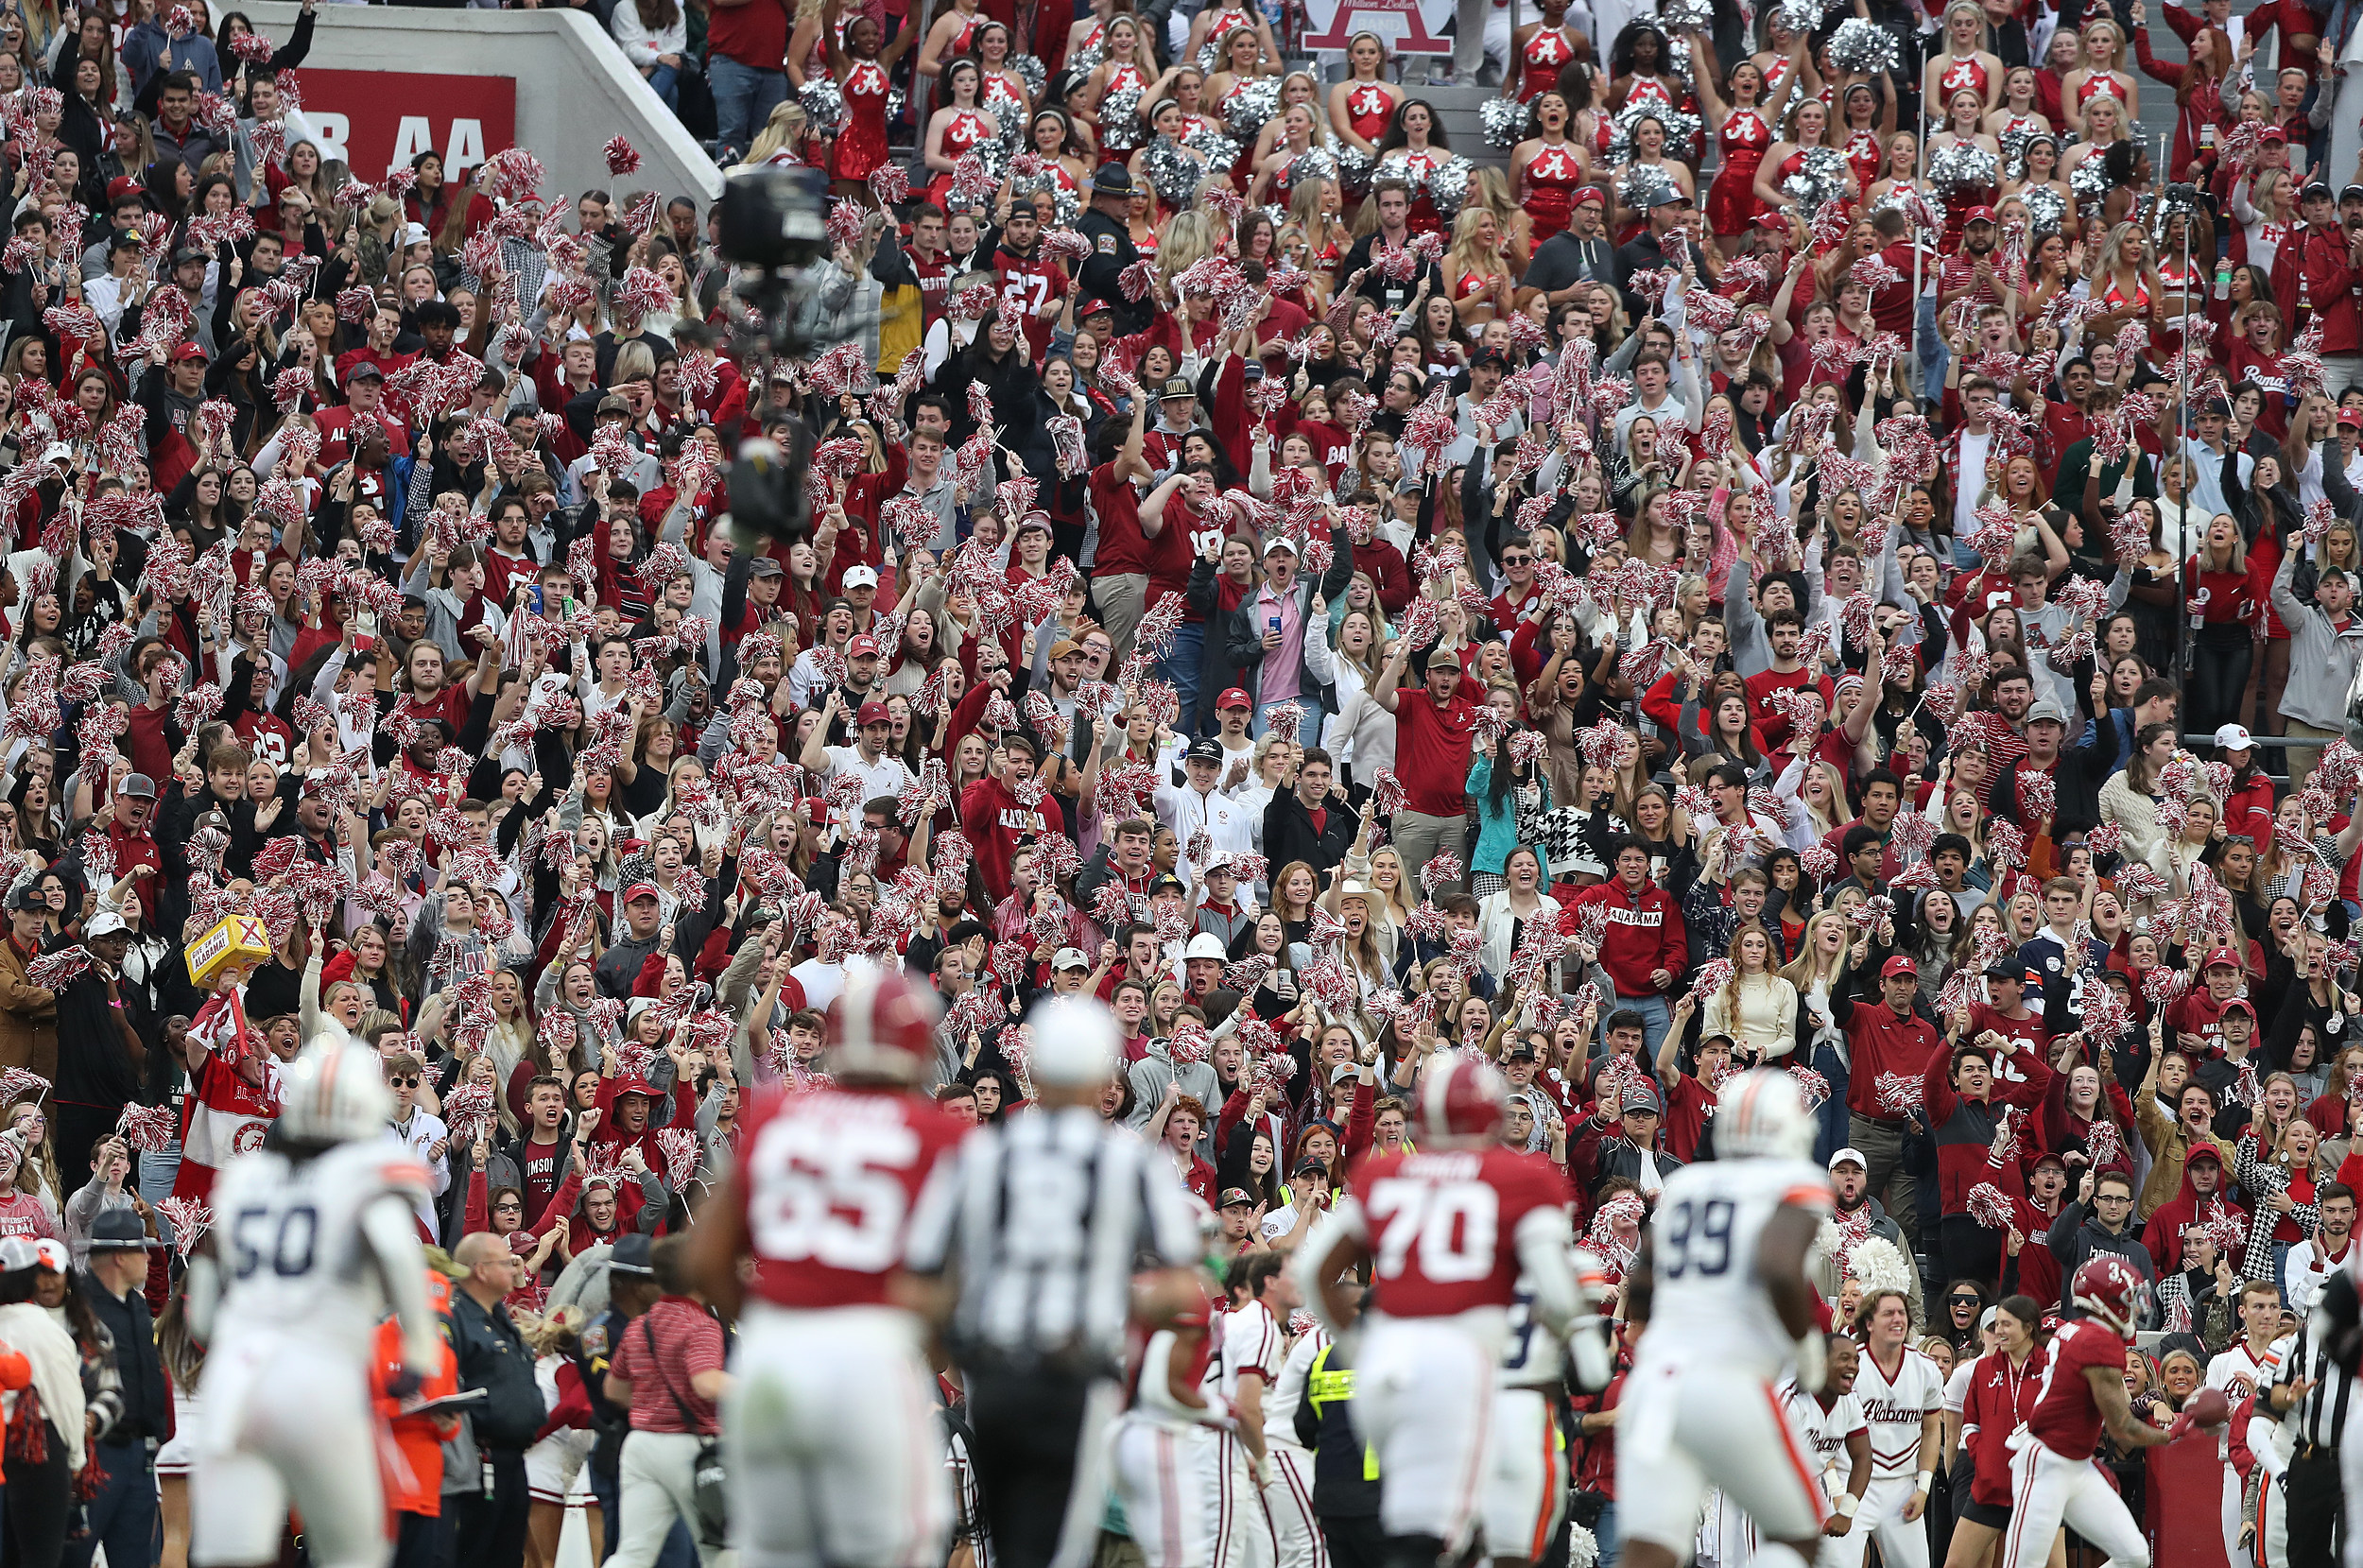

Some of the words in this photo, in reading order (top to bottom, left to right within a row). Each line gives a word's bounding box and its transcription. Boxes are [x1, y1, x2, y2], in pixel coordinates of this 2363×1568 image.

[1381, 0, 1417, 10] Dollar
[1355, 17, 1401, 32] BAND
[1527, 37, 1559, 65] A
[1943, 63, 1975, 88] A
[854, 68, 885, 95] A
[1353, 89, 1384, 115] A
[951, 116, 980, 143] A
[1726, 115, 1756, 142] A
[1840, 137, 1871, 160] A
[1532, 152, 1567, 181] A
[127, 177, 138, 187] A
[1974, 208, 1986, 216] A
[1005, 270, 1048, 316] 27
[1094, 299, 1104, 308] A
[189, 344, 201, 353] A
[1485, 348, 1497, 357] A
[2241, 365, 2287, 388] Bama
[437, 702, 444, 713] A
[1457, 713, 1466, 723] A
[1812, 751, 1821, 762] A
[885, 781, 893, 790] A
[145, 848, 155, 859] A
[1215, 853, 1228, 864] A
[1048, 899, 1060, 909] A
[1651, 901, 1662, 910] A
[108, 915, 121, 926] A
[195, 937, 227, 969] ALABAMA!
[1071, 949, 1081, 958] A
[2214, 949, 2228, 959] A
[1895, 957, 1909, 967] A
[123, 1000, 131, 1008] A
[2011, 1027, 2020, 1037] A
[1916, 1035, 1924, 1044] A
[628, 1073, 638, 1081] A
[421, 1131, 431, 1144] A
[710, 1137, 721, 1148] A
[244, 1134, 265, 1153] A
[1304, 1156, 1316, 1165] A
[503, 1170, 510, 1179] A
[749, 1120, 921, 1269] 65
[1194, 1181, 1205, 1197] A
[1367, 1178, 1500, 1284] 70
[233, 1204, 318, 1279] 50
[2108, 1262, 2120, 1283] 3
[1222, 1301, 1231, 1313] A
[2043, 1317, 2057, 1328] A
